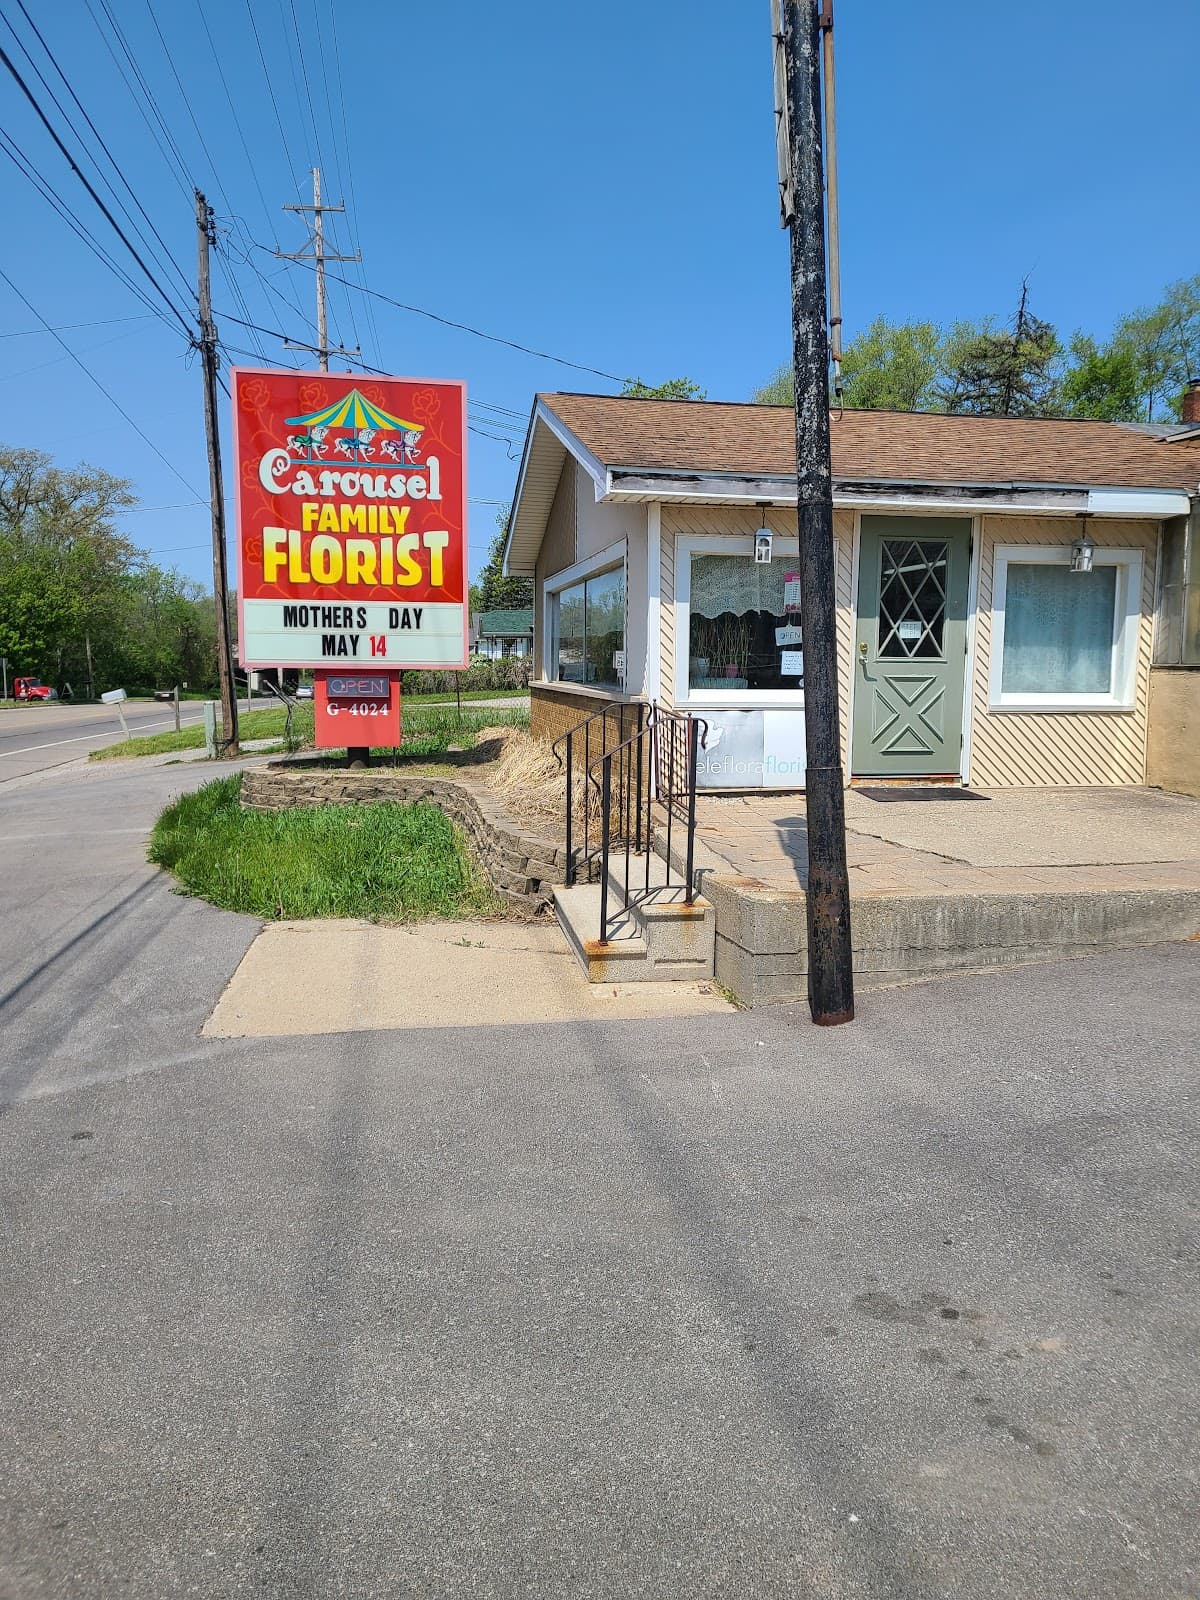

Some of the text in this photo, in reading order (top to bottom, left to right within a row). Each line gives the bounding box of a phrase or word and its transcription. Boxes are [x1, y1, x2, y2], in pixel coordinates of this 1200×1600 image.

[259, 448, 442, 500] Carousel
[302, 502, 411, 534] FAMILY
[263, 526, 449, 586] FLORIST
[283, 606, 423, 629] MOTHERS DAY
[322, 635, 387, 656] MAY 14
[780, 631, 801, 639] OPEN
[331, 680, 384, 693] OPEN
[327, 703, 389, 716] G-4024
